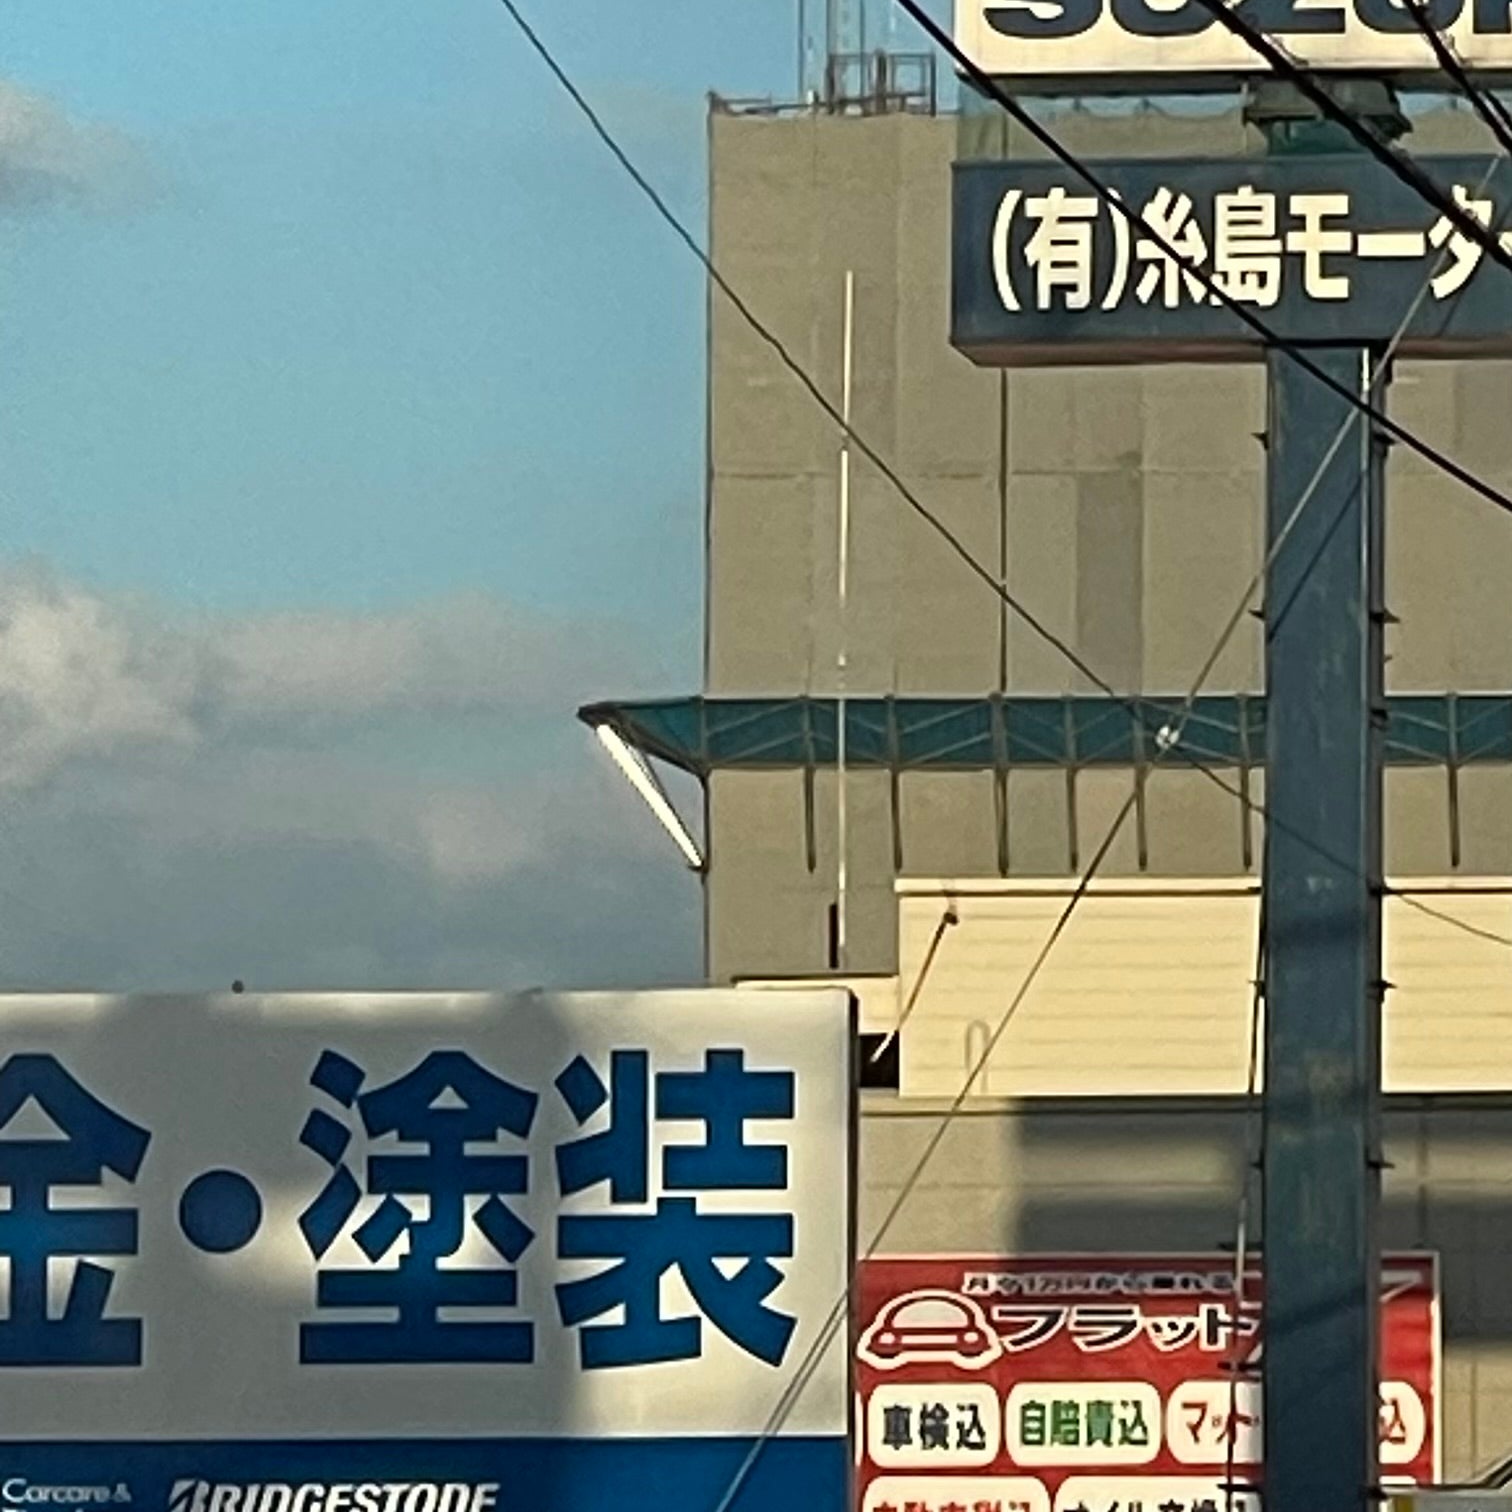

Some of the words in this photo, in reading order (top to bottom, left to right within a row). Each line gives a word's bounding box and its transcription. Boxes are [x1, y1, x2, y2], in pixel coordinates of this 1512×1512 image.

[882, 1402, 987, 1451] 車検込
[167, 1480, 500, 1512] BRIDGESTONE
